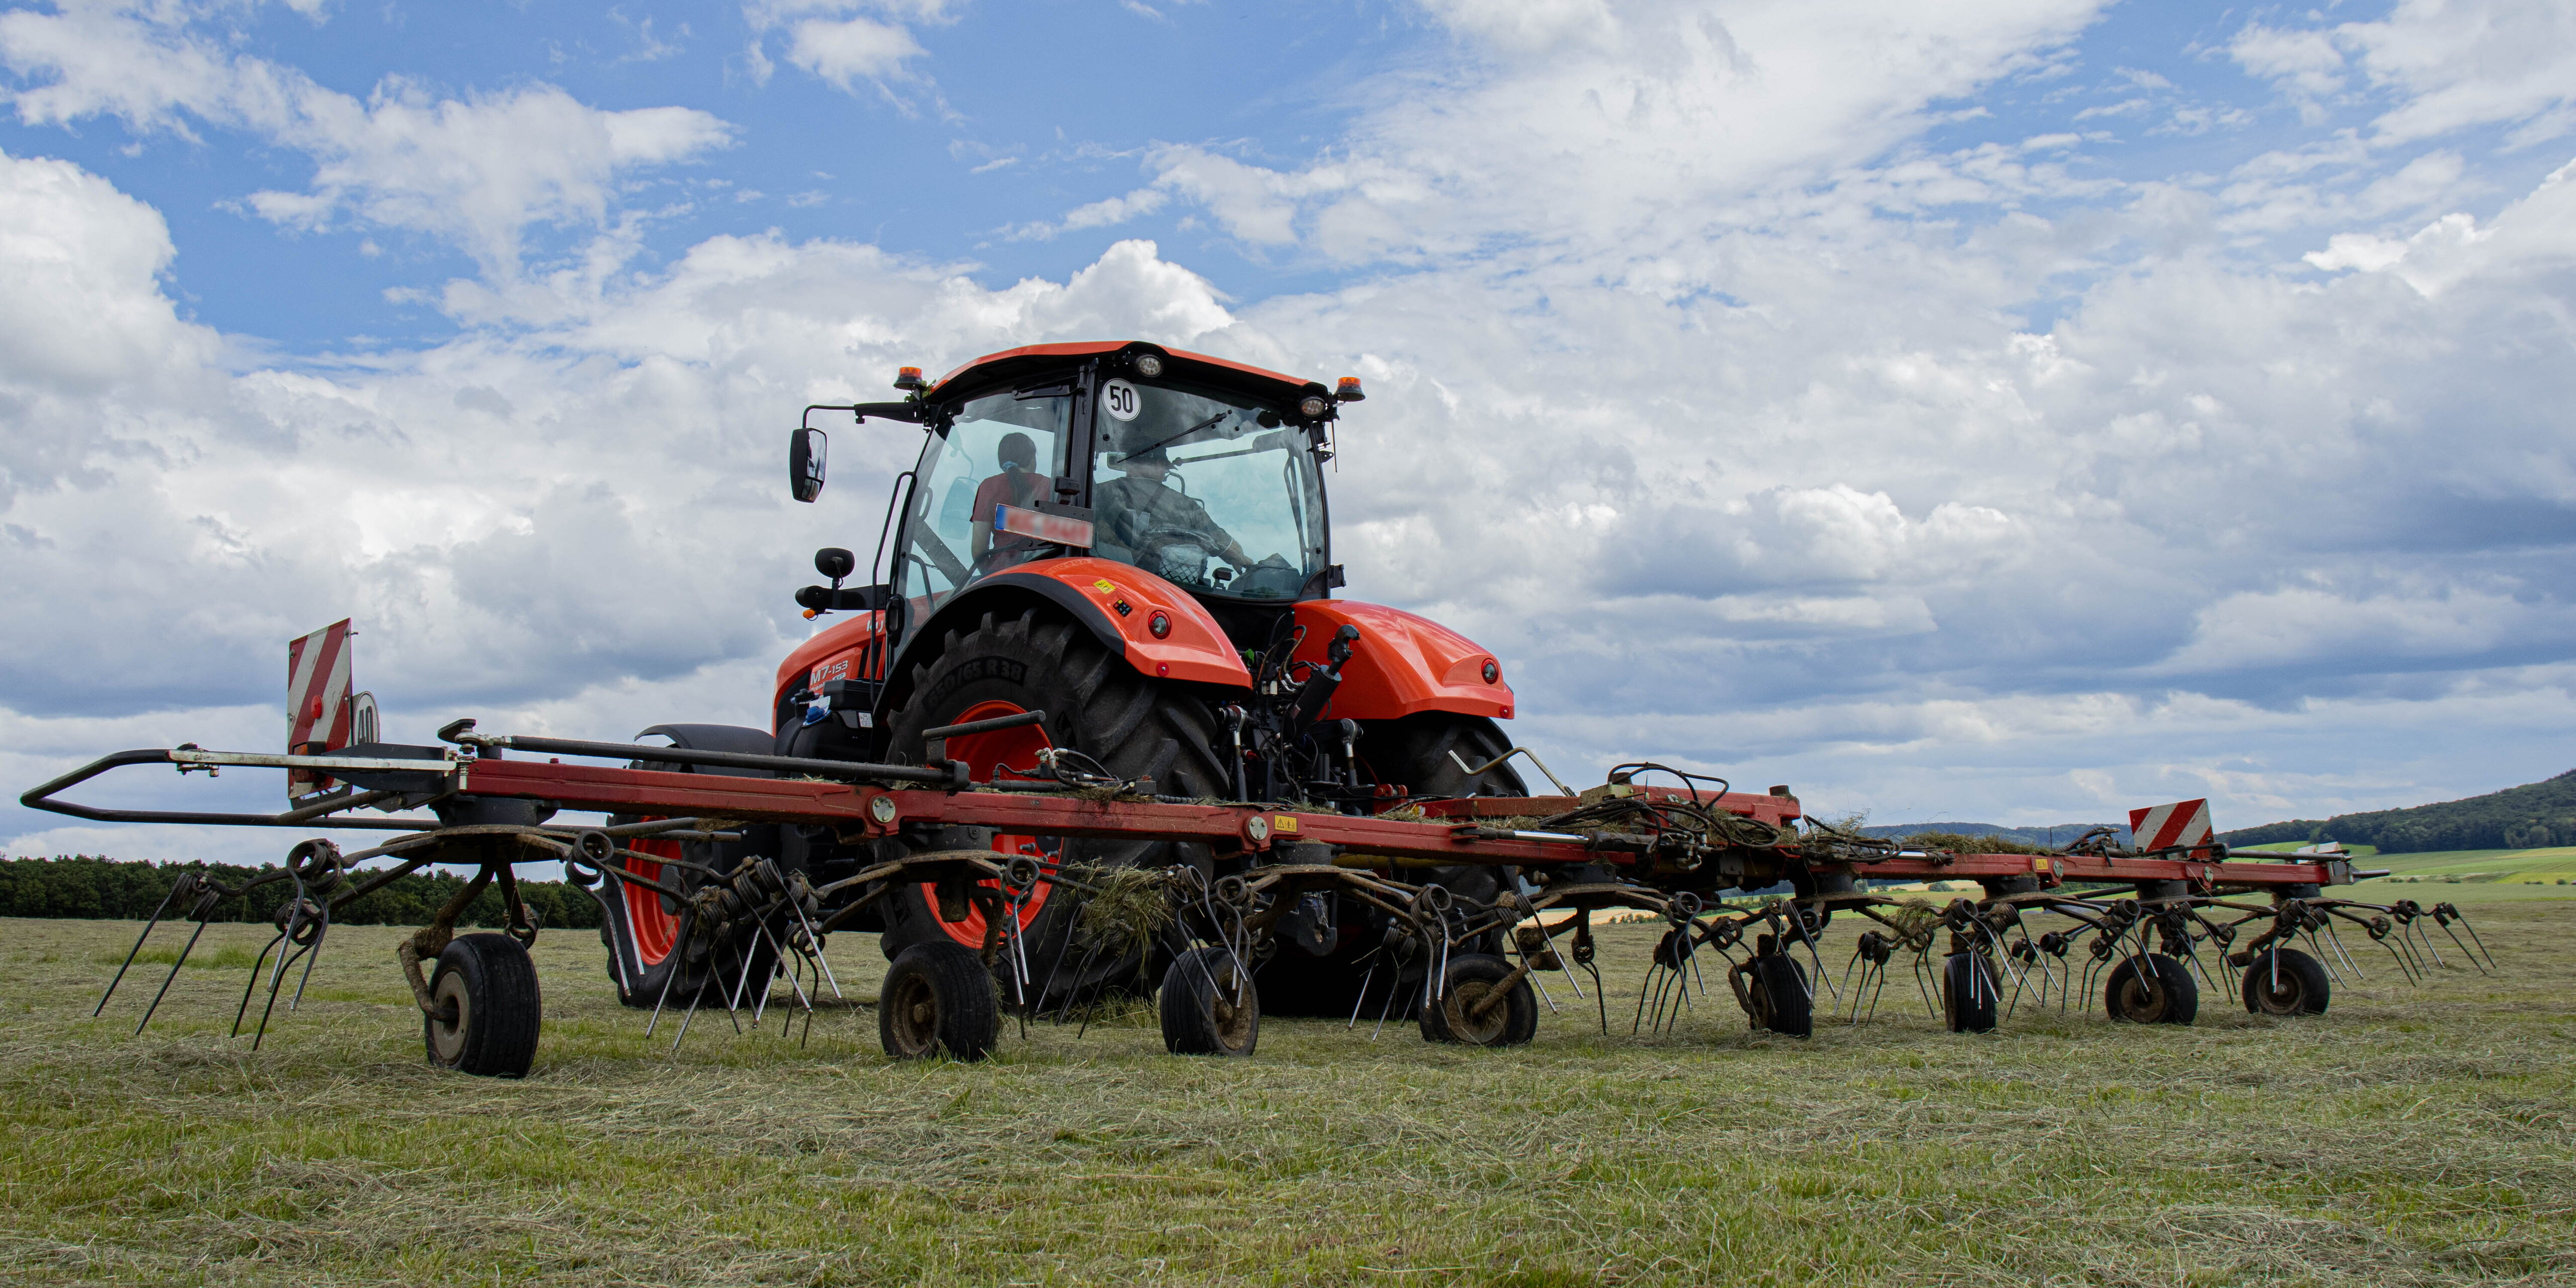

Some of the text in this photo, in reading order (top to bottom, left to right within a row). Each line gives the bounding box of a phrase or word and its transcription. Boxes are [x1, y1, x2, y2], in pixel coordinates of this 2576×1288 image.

[1110, 385, 1133, 414] 50
[810, 660, 848, 686] M7-153
[986, 659, 998, 676] R
[1001, 660, 1022, 681] 38
[358, 705, 374, 744] 40
